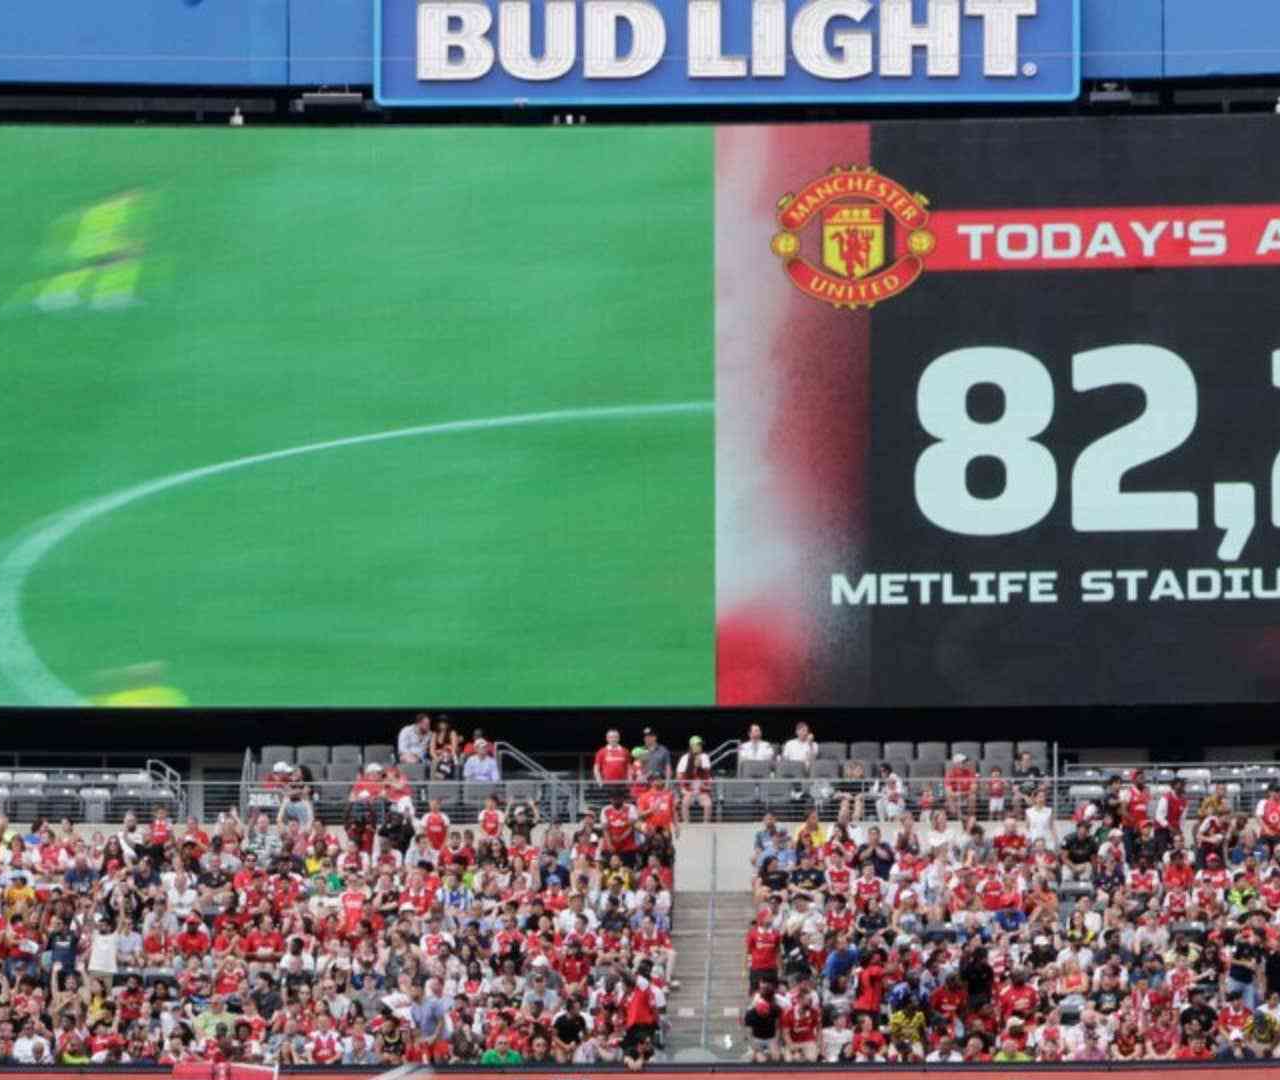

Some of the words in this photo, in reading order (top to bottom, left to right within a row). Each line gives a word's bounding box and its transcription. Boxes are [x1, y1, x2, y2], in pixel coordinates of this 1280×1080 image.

[416, 0, 666, 80] BUD
[688, 0, 1037, 79] LIGHT
[789, 177, 918, 221] MANCHESTER
[957, 219, 1228, 260] TODAY'S
[810, 274, 900, 300] UNITED
[830, 571, 1058, 606] METLIFE
